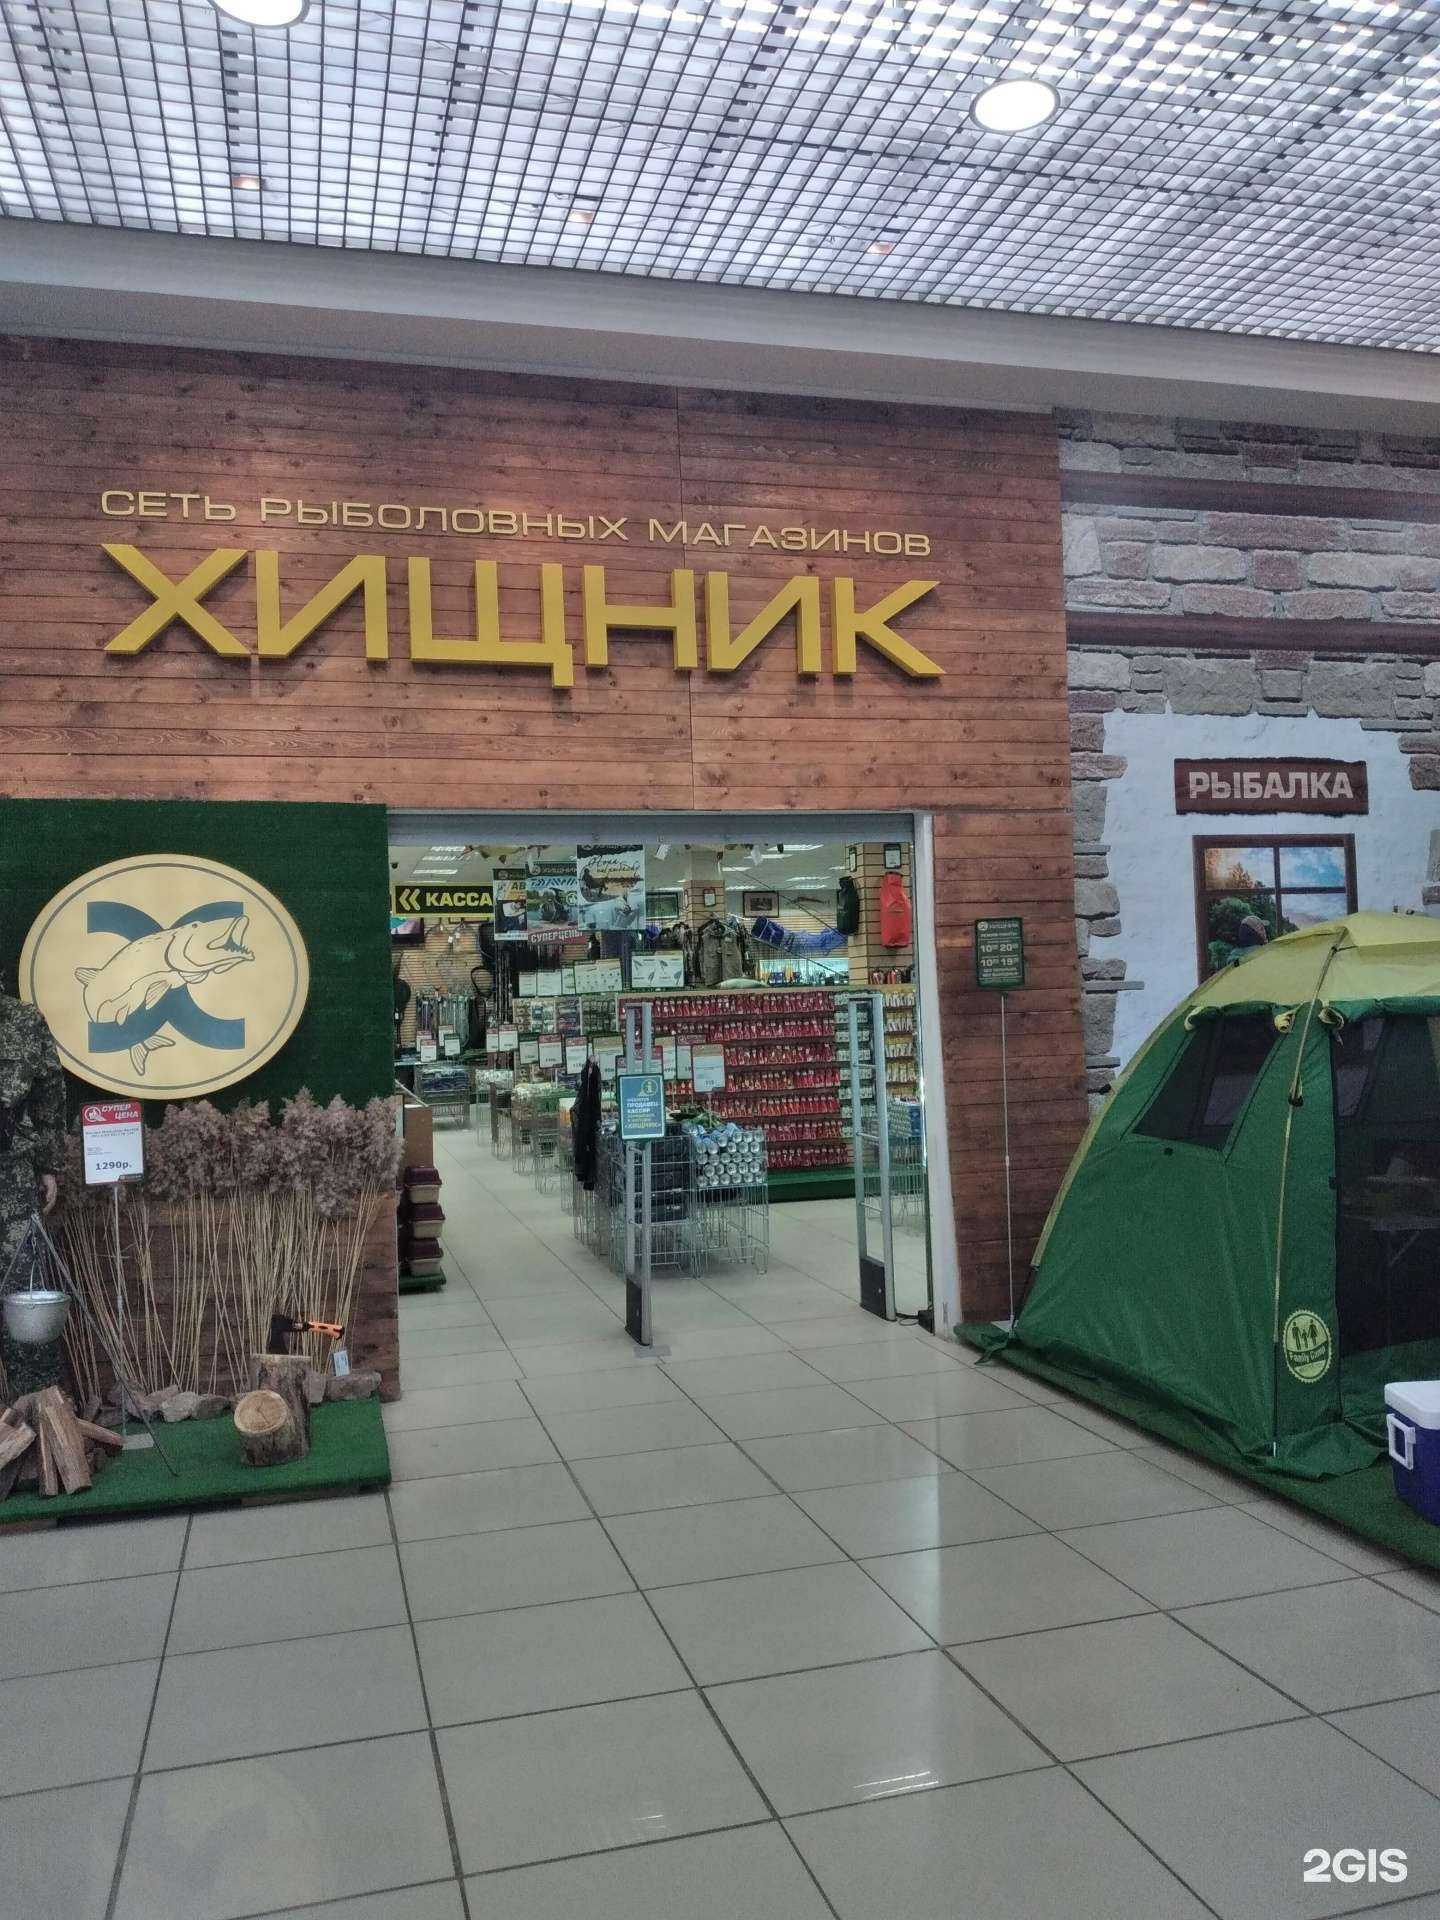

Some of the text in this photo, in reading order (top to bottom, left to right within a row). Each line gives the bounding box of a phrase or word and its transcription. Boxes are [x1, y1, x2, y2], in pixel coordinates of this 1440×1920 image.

[100, 489, 933, 557] СЕТЬ РЫБОЛОВНЫХ МАГАЗИНОВ
[101, 543, 946, 689] ХИЩНИК
[1188, 771, 1355, 799] РЫБАЛКА
[425, 892, 493, 907] КАССА
[101, 1104, 131, 1113] СУПЕР
[115, 1112, 138, 1120] ЦЕНА
